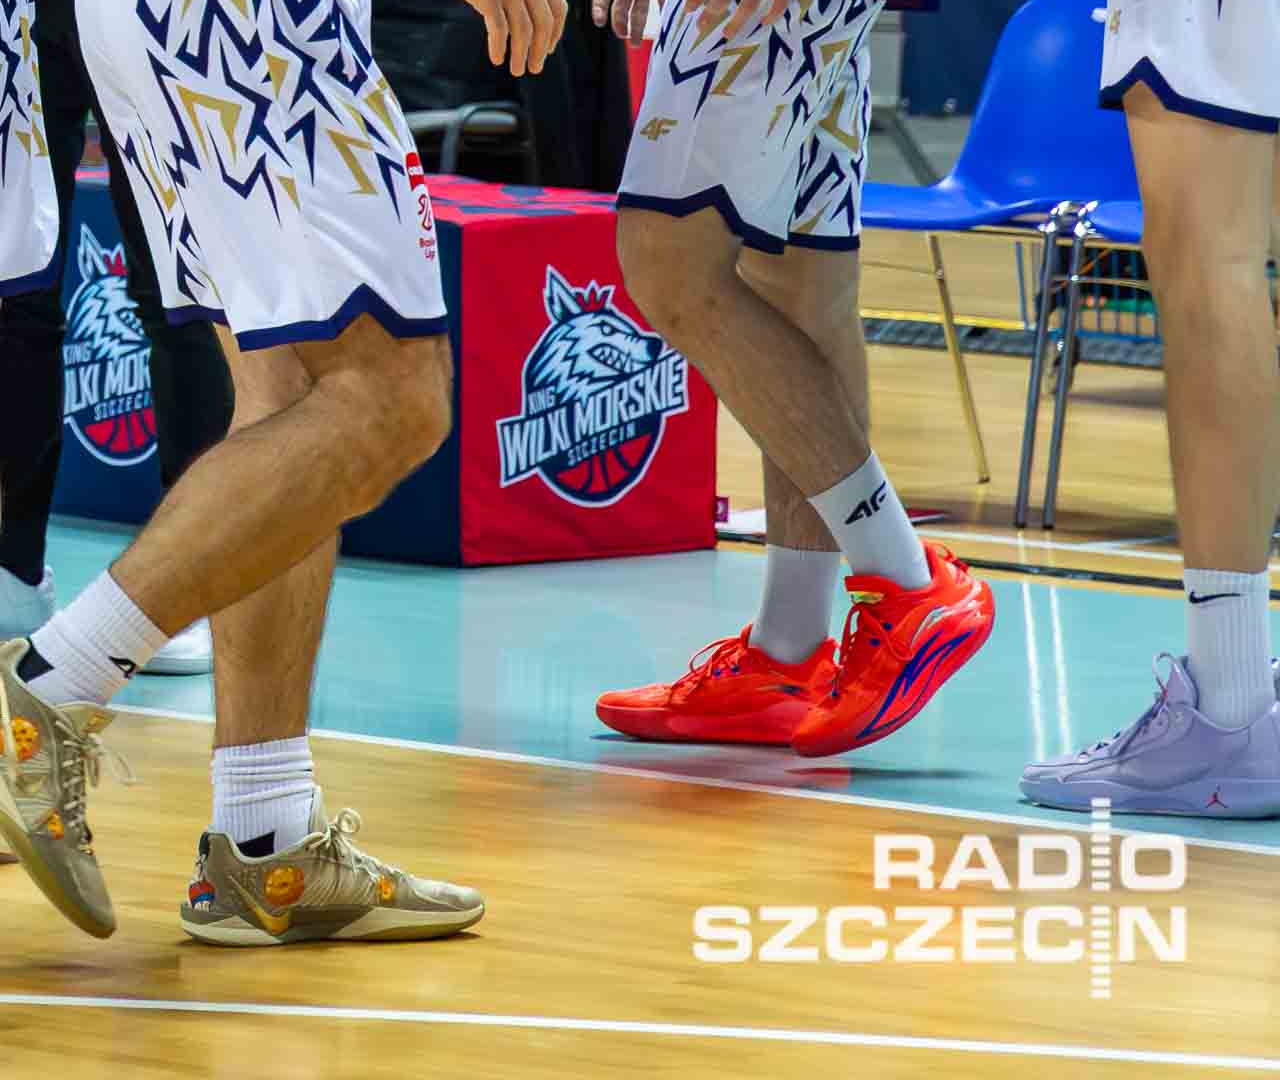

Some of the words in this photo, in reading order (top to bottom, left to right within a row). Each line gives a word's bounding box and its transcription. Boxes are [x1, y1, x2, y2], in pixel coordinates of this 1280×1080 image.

[503, 407, 571, 477] WILKI
[574, 353, 685, 443] MORSKIE
[528, 386, 556, 415] KING
[567, 421, 637, 467] SZCZECIN
[844, 480, 887, 525] 4F
